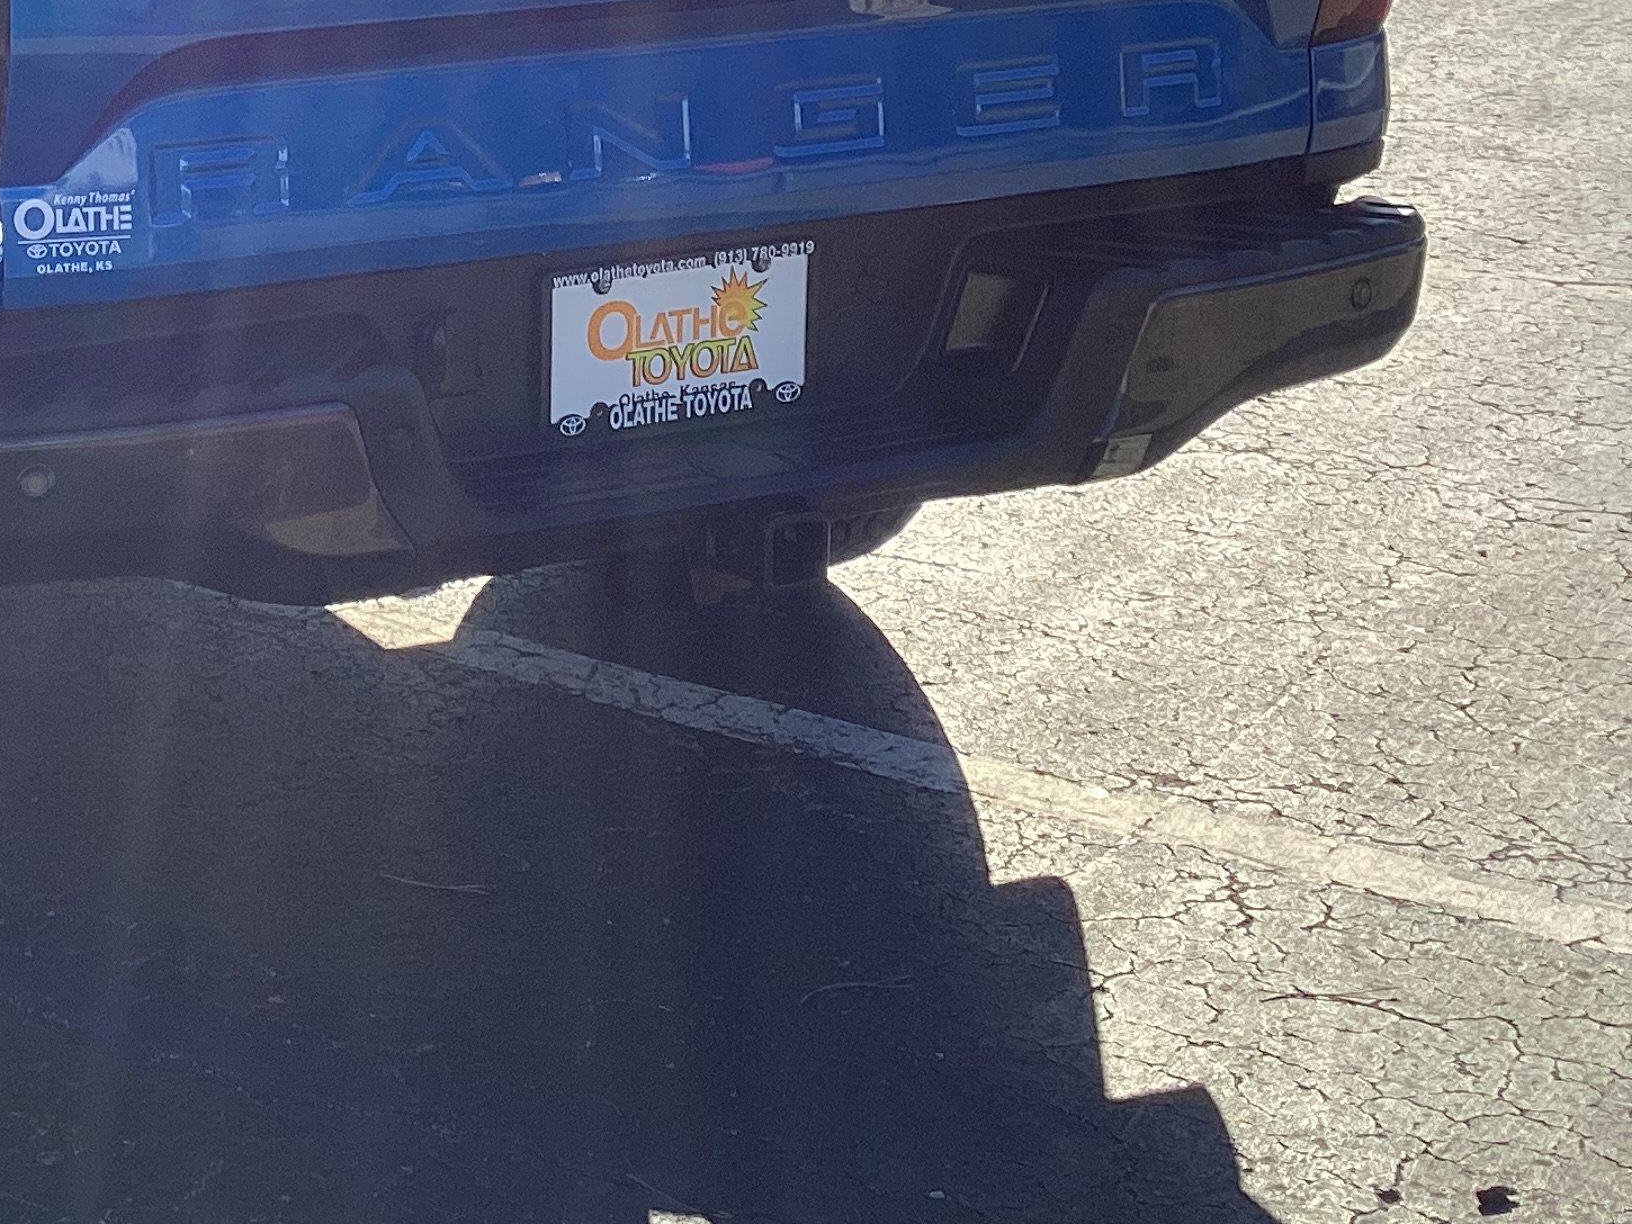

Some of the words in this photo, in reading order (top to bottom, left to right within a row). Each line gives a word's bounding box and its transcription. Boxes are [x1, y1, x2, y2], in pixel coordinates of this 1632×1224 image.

[149, 38, 1222, 226] RANGER
[14, 199, 132, 239] OLATHE
[54, 193, 88, 206] Kenny
[36, 262, 93, 274] OLATHE,
[96, 260, 114, 271] KS
[49, 240, 122, 257] TOYOTA
[553, 257, 706, 288] www.olathetoyota.com
[714, 248, 748, 266] (913)
[751, 240, 816, 261] 780-9919
[626, 335, 759, 387] TOYOTA
[609, 397, 679, 430] OLATHE
[683, 387, 754, 418] TOYOTA
